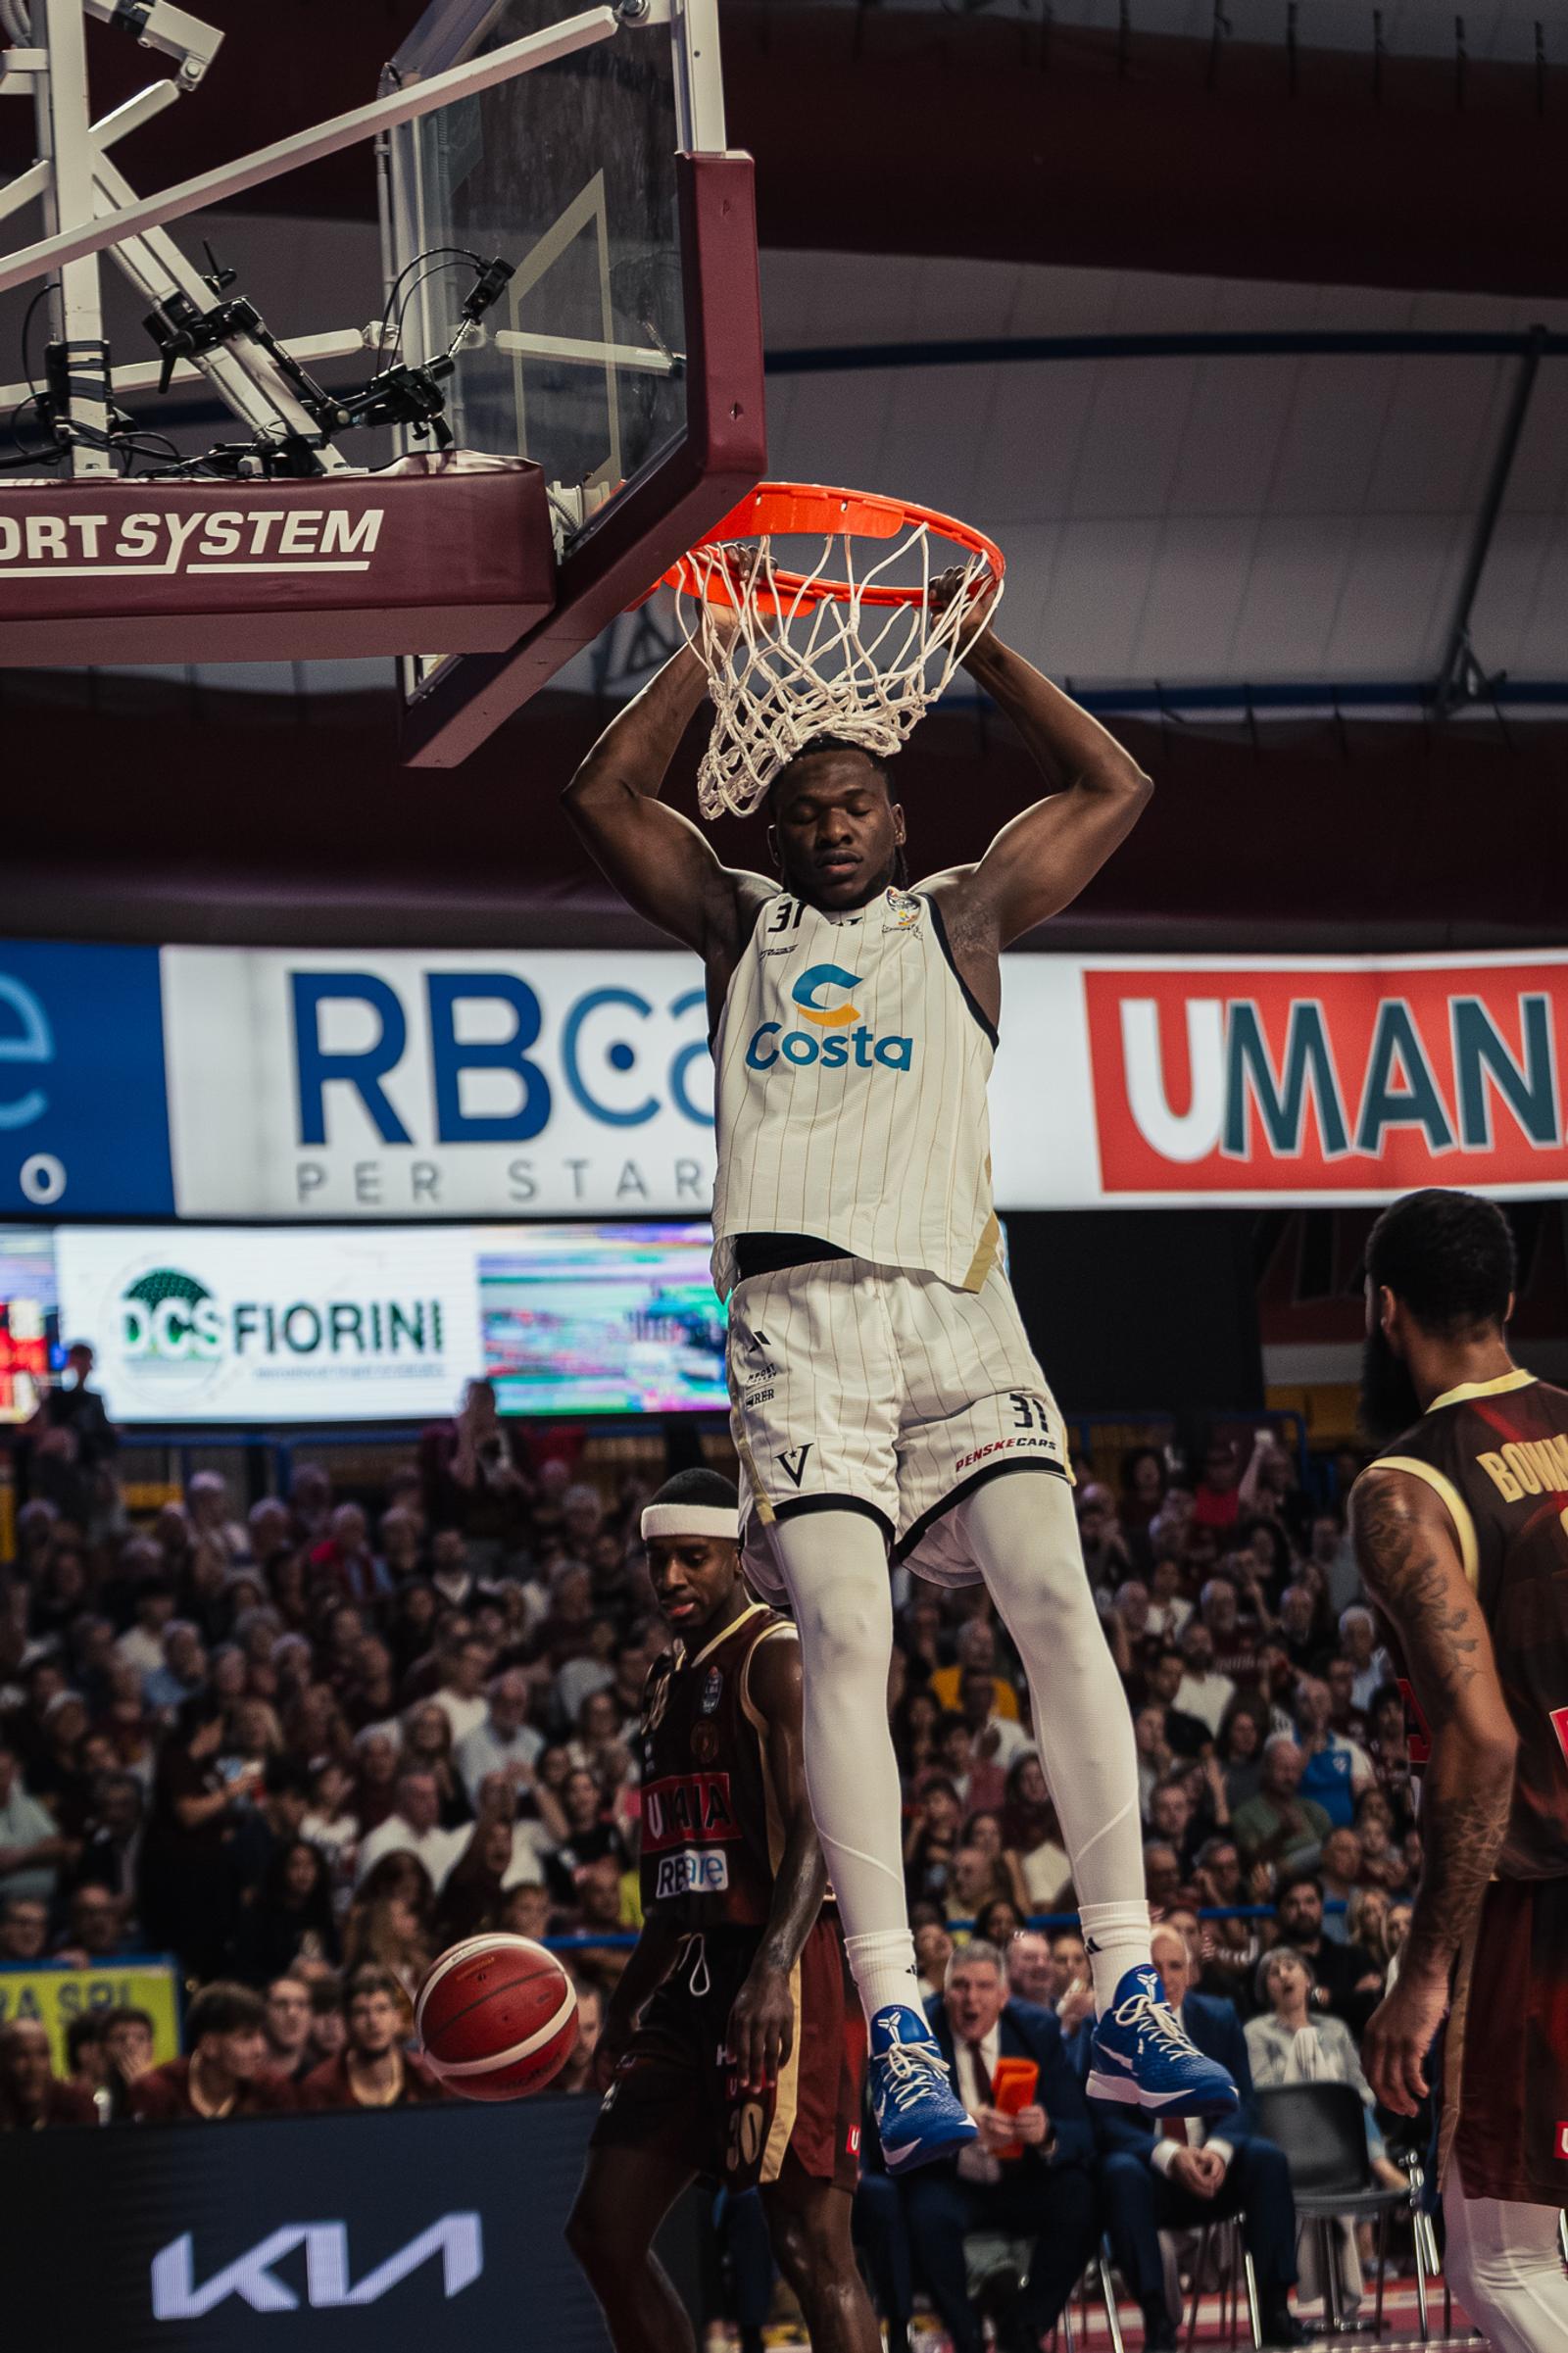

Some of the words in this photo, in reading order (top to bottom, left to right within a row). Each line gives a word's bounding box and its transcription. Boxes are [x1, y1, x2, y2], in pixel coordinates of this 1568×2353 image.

[116, 509, 383, 572] SYSTEM
[767, 901, 808, 932] 31
[745, 1021, 913, 1072] Costa
[296, 1160, 442, 1205] PER
[232, 1300, 444, 1354] FIORINI
[1009, 1393, 1049, 1433] 31
[956, 1437, 1056, 1472] PENSKECARS
